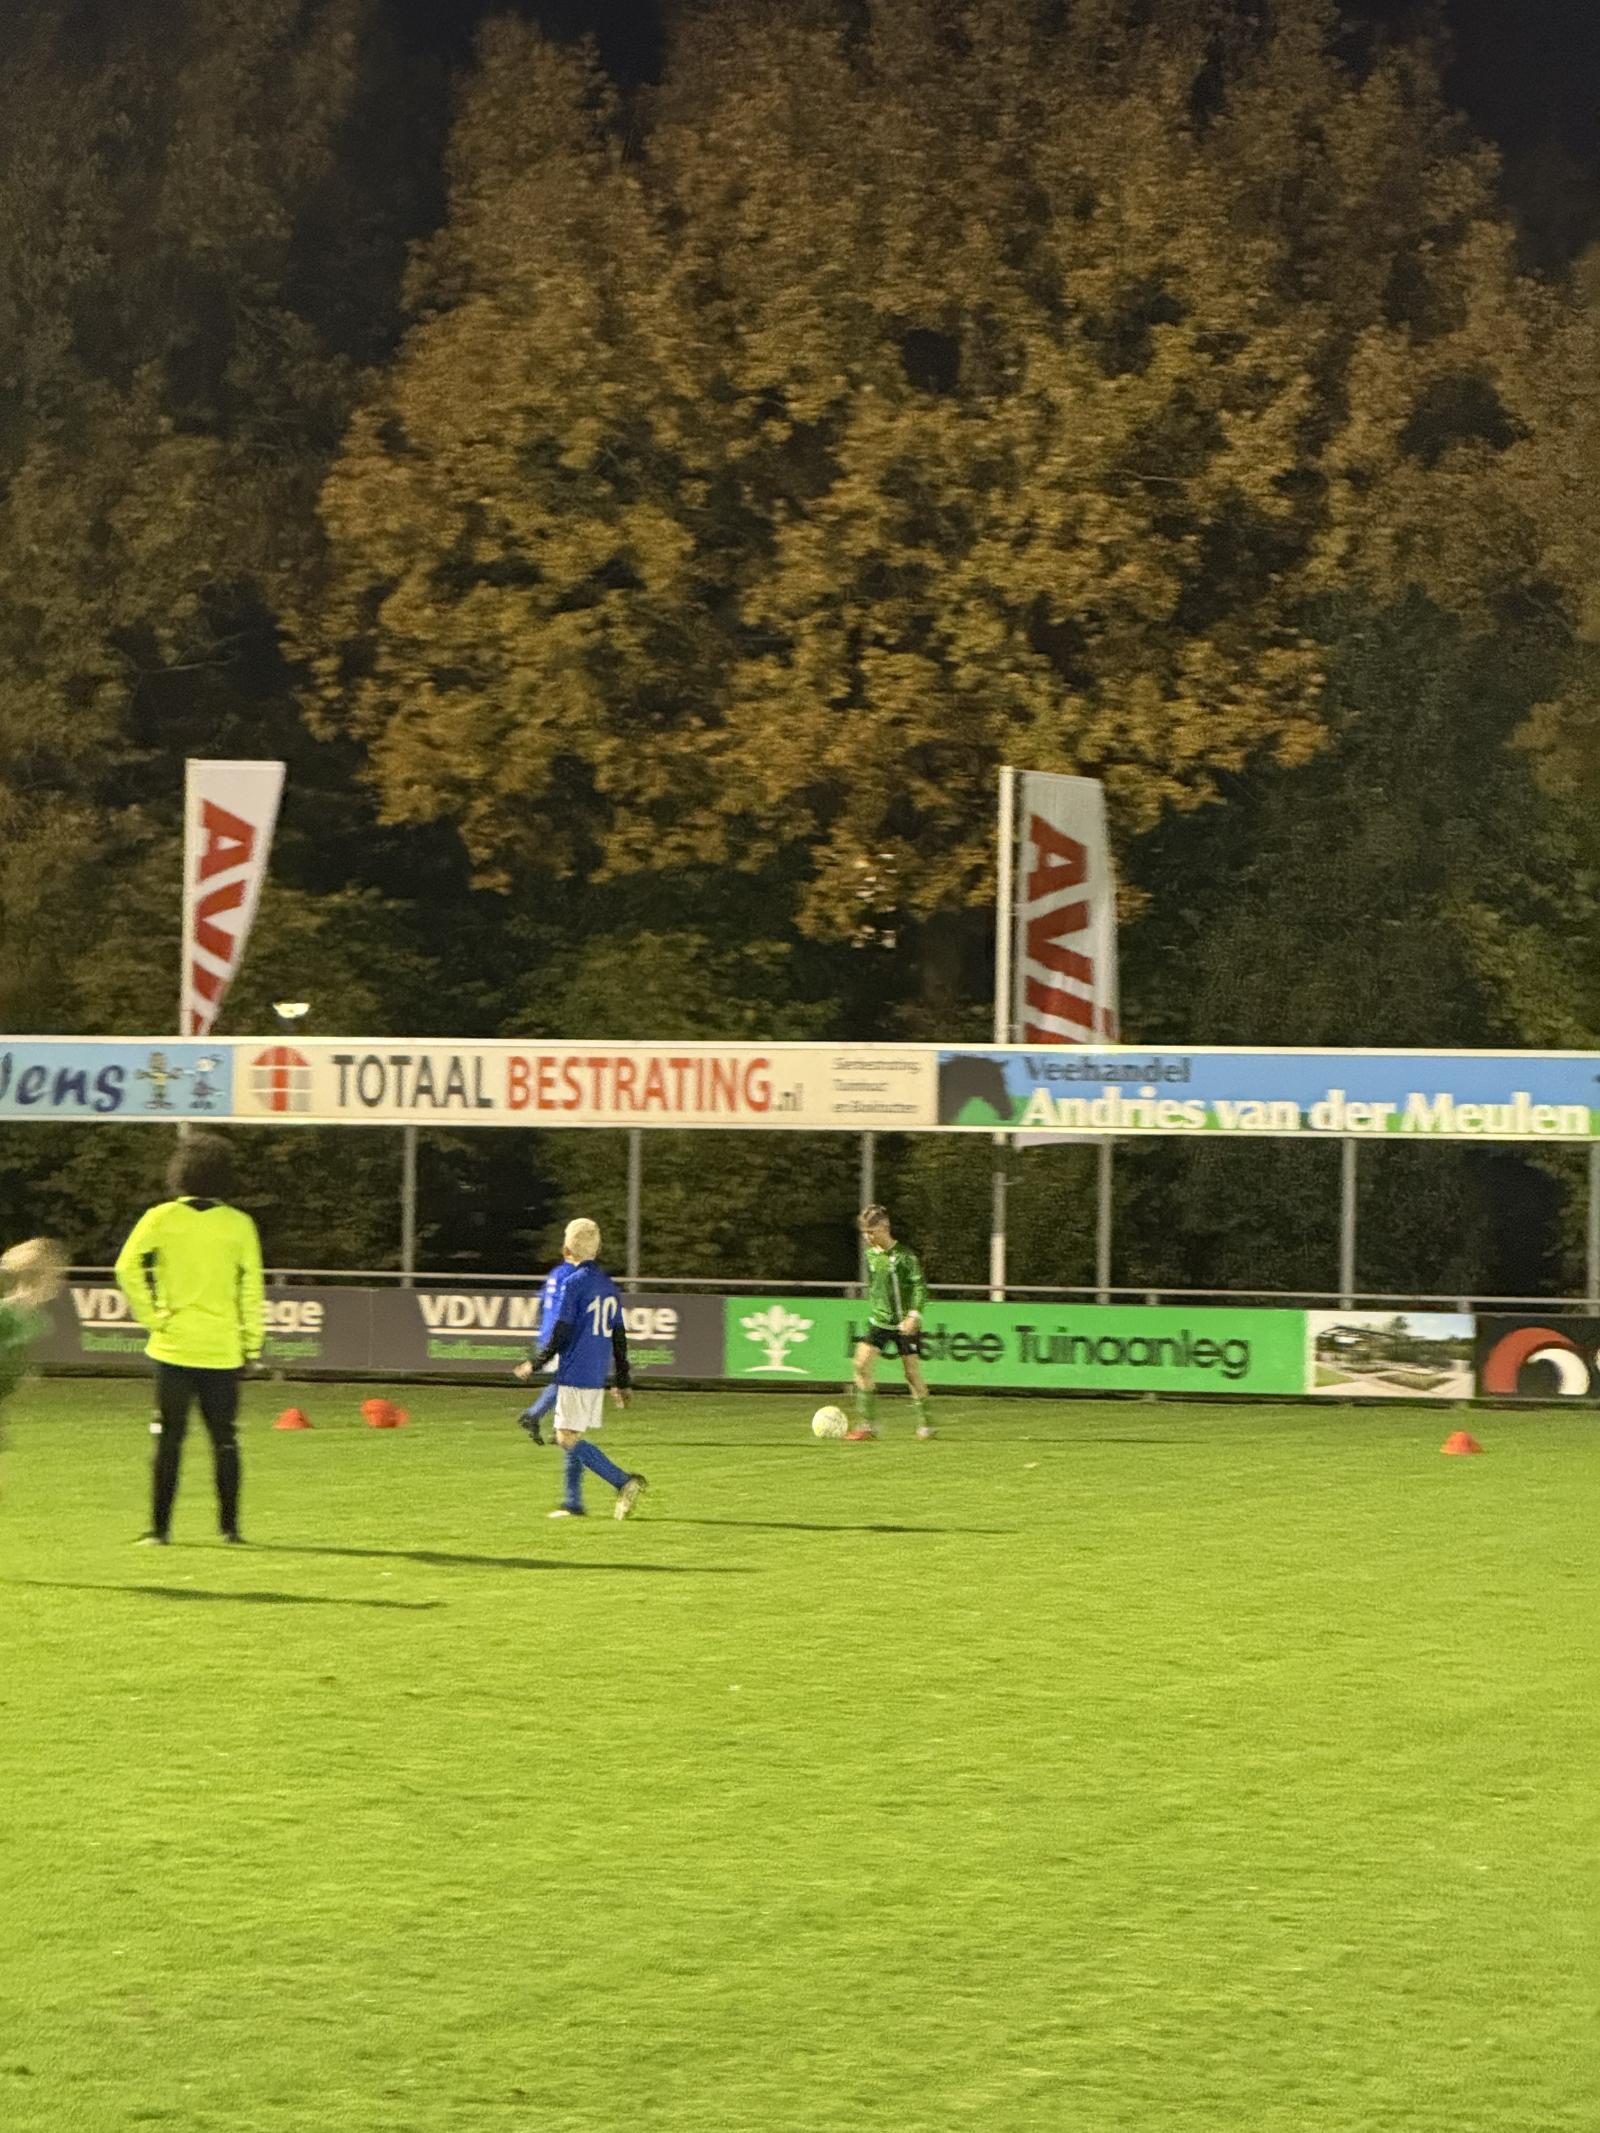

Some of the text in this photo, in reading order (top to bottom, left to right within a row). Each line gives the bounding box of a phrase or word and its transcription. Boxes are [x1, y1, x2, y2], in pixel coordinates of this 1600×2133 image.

[190, 798, 256, 1036] AVI
[1023, 813, 1095, 1045] AVI
[332, 1053, 494, 1109] TOTAAL
[1025, 1055, 1191, 1083] Veehandel
[1019, 1085, 1591, 1135] Andries van der Meulen
[70, 1288, 134, 1320] VD
[417, 1294, 501, 1328] VDV
[586, 1295, 618, 1338] 10
[1014, 1324, 1250, 1379] Tuinaanleg
